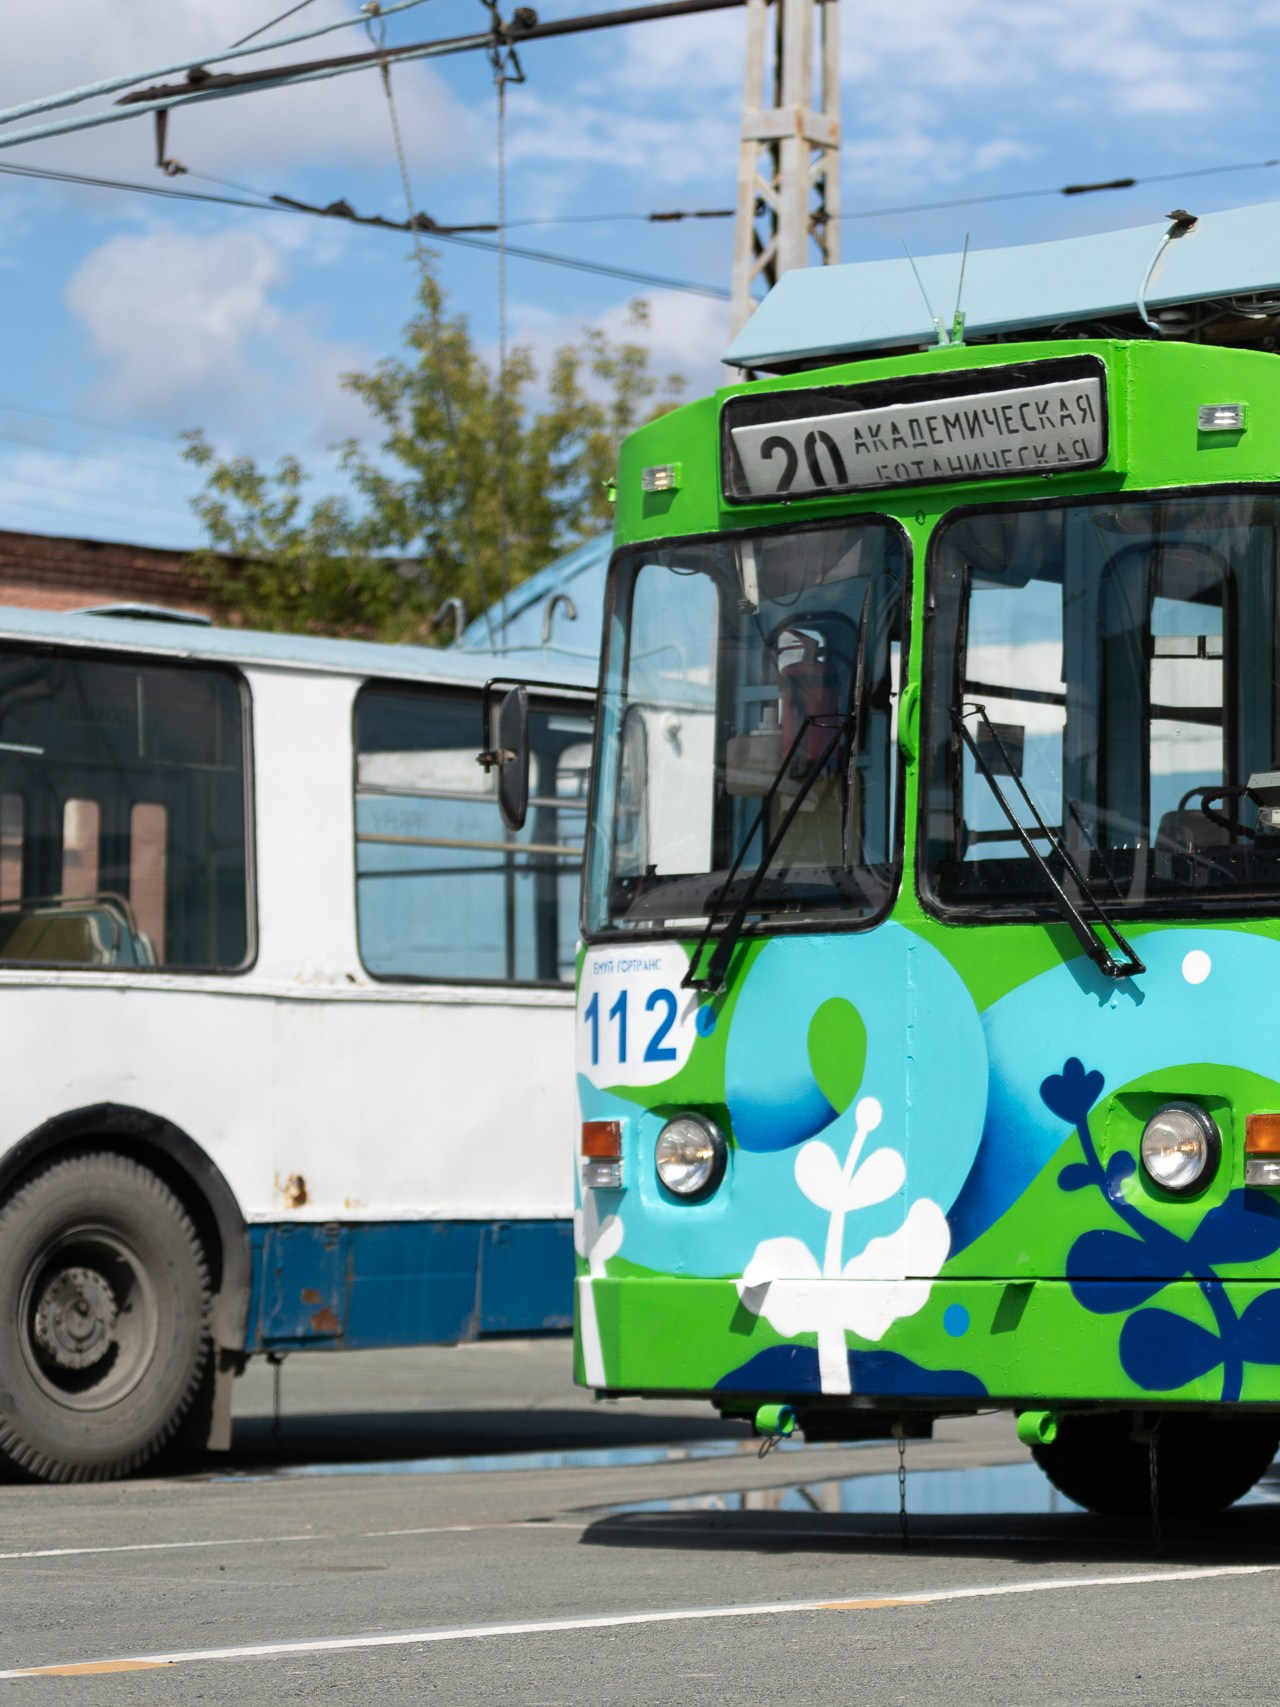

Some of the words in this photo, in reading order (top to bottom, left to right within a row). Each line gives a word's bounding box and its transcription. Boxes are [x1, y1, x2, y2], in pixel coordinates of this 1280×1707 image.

[854, 394, 1096, 455] АКАДЕМИЧЕСКАЯ
[760, 430, 848, 493] 20
[616, 958, 662, 973] ГОРТРАНС
[584, 988, 678, 1065] 112
